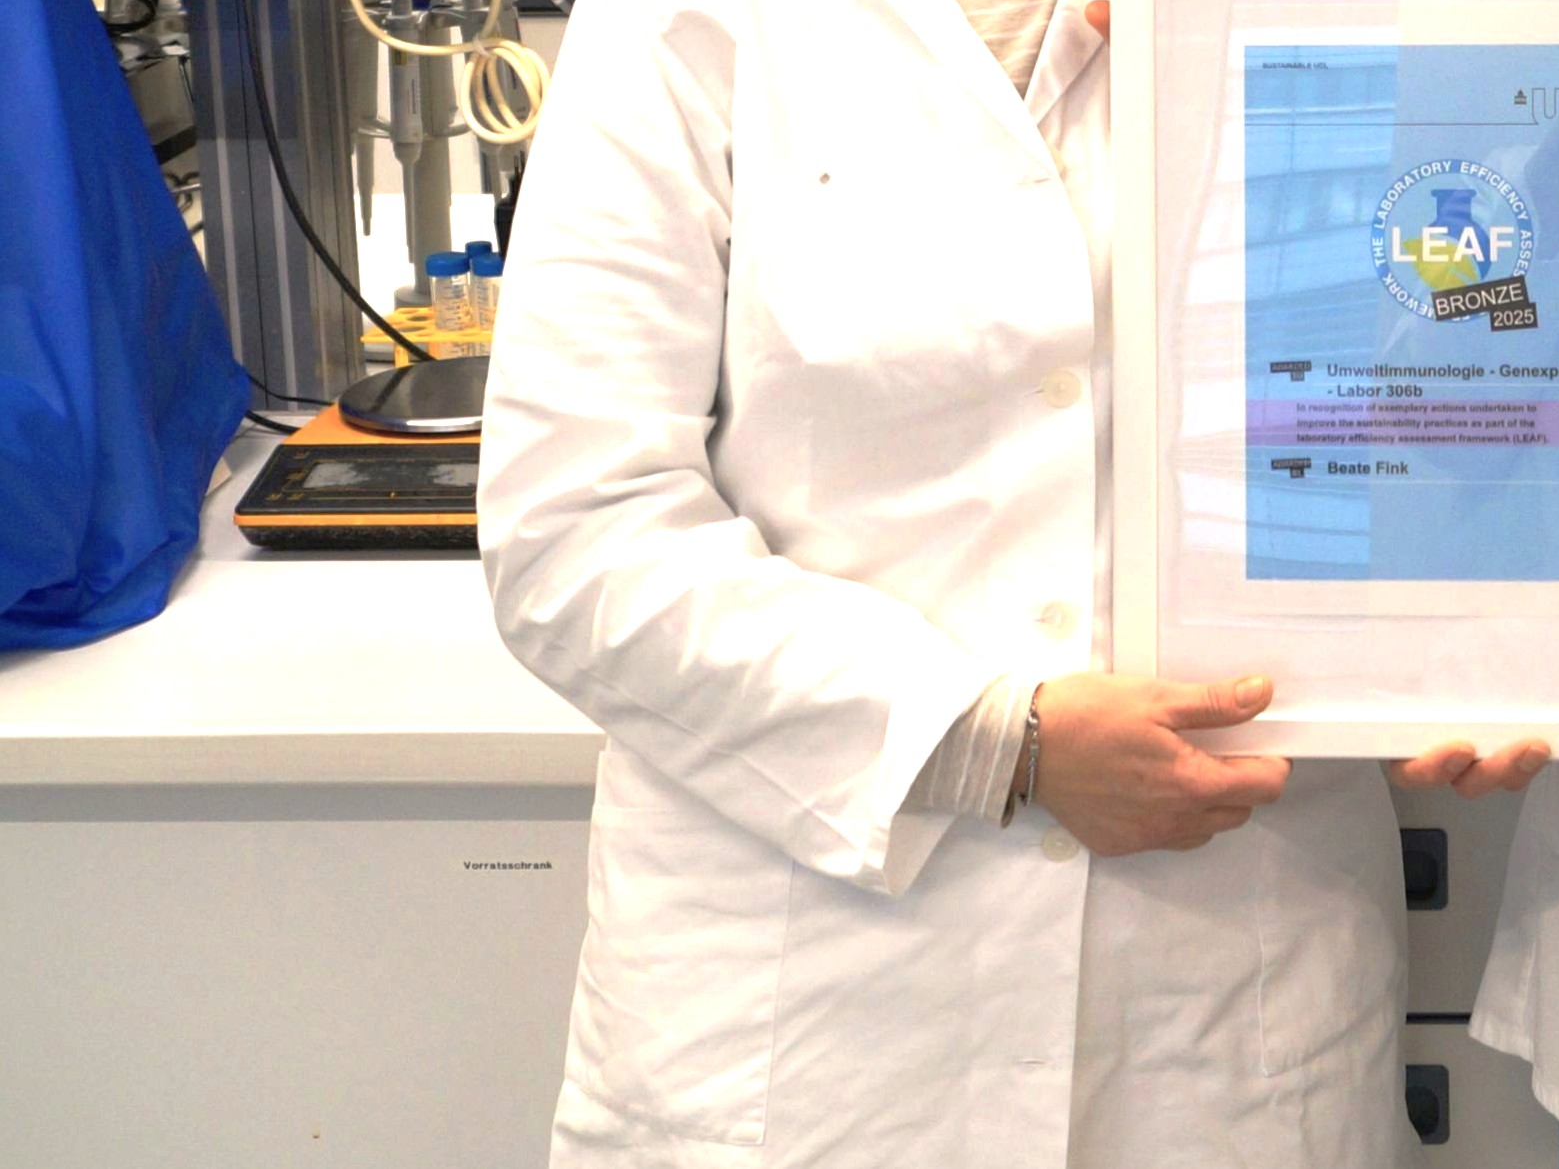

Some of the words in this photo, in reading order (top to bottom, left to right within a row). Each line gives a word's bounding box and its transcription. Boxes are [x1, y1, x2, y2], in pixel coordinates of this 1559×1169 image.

[1375, 160, 1453, 230] LABORATORY
[1460, 161, 1530, 220] EFFICIENCY
[1372, 237, 1387, 268] THE
[1391, 226, 1515, 263] LEAF
[1513, 229, 1533, 277] ASSES
[1435, 283, 1524, 316] BRONZE
[1493, 309, 1534, 327] 2025
[1327, 363, 1485, 380] Umweltimmunologie
[1337, 384, 1382, 398] Labor
[1386, 384, 1423, 398] 306b
[1309, 403, 1364, 415] recognition
[1366, 403, 1376, 412] of
[1378, 403, 1428, 415] exemplary
[1431, 404, 1466, 413] actions
[1469, 404, 1525, 413] undertaken
[1527, 404, 1537, 413] to
[1297, 419, 1336, 430] improve
[1339, 418, 1354, 428] the
[1356, 418, 1421, 430] sustainability
[1424, 418, 1469, 430] practices
[1471, 420, 1482, 428] as
[1485, 419, 1505, 430] part
[1507, 418, 1518, 428] of
[1520, 418, 1535, 428] the
[1297, 433, 1346, 445] laboratory
[1348, 433, 1395, 445] efficiency
[1398, 434, 1457, 443] assessment
[1458, 433, 1511, 443] framework
[1327, 461, 1371, 475] Beate
[1376, 461, 1409, 475] Fink
[463, 861, 552, 870] Vorratsschrank
